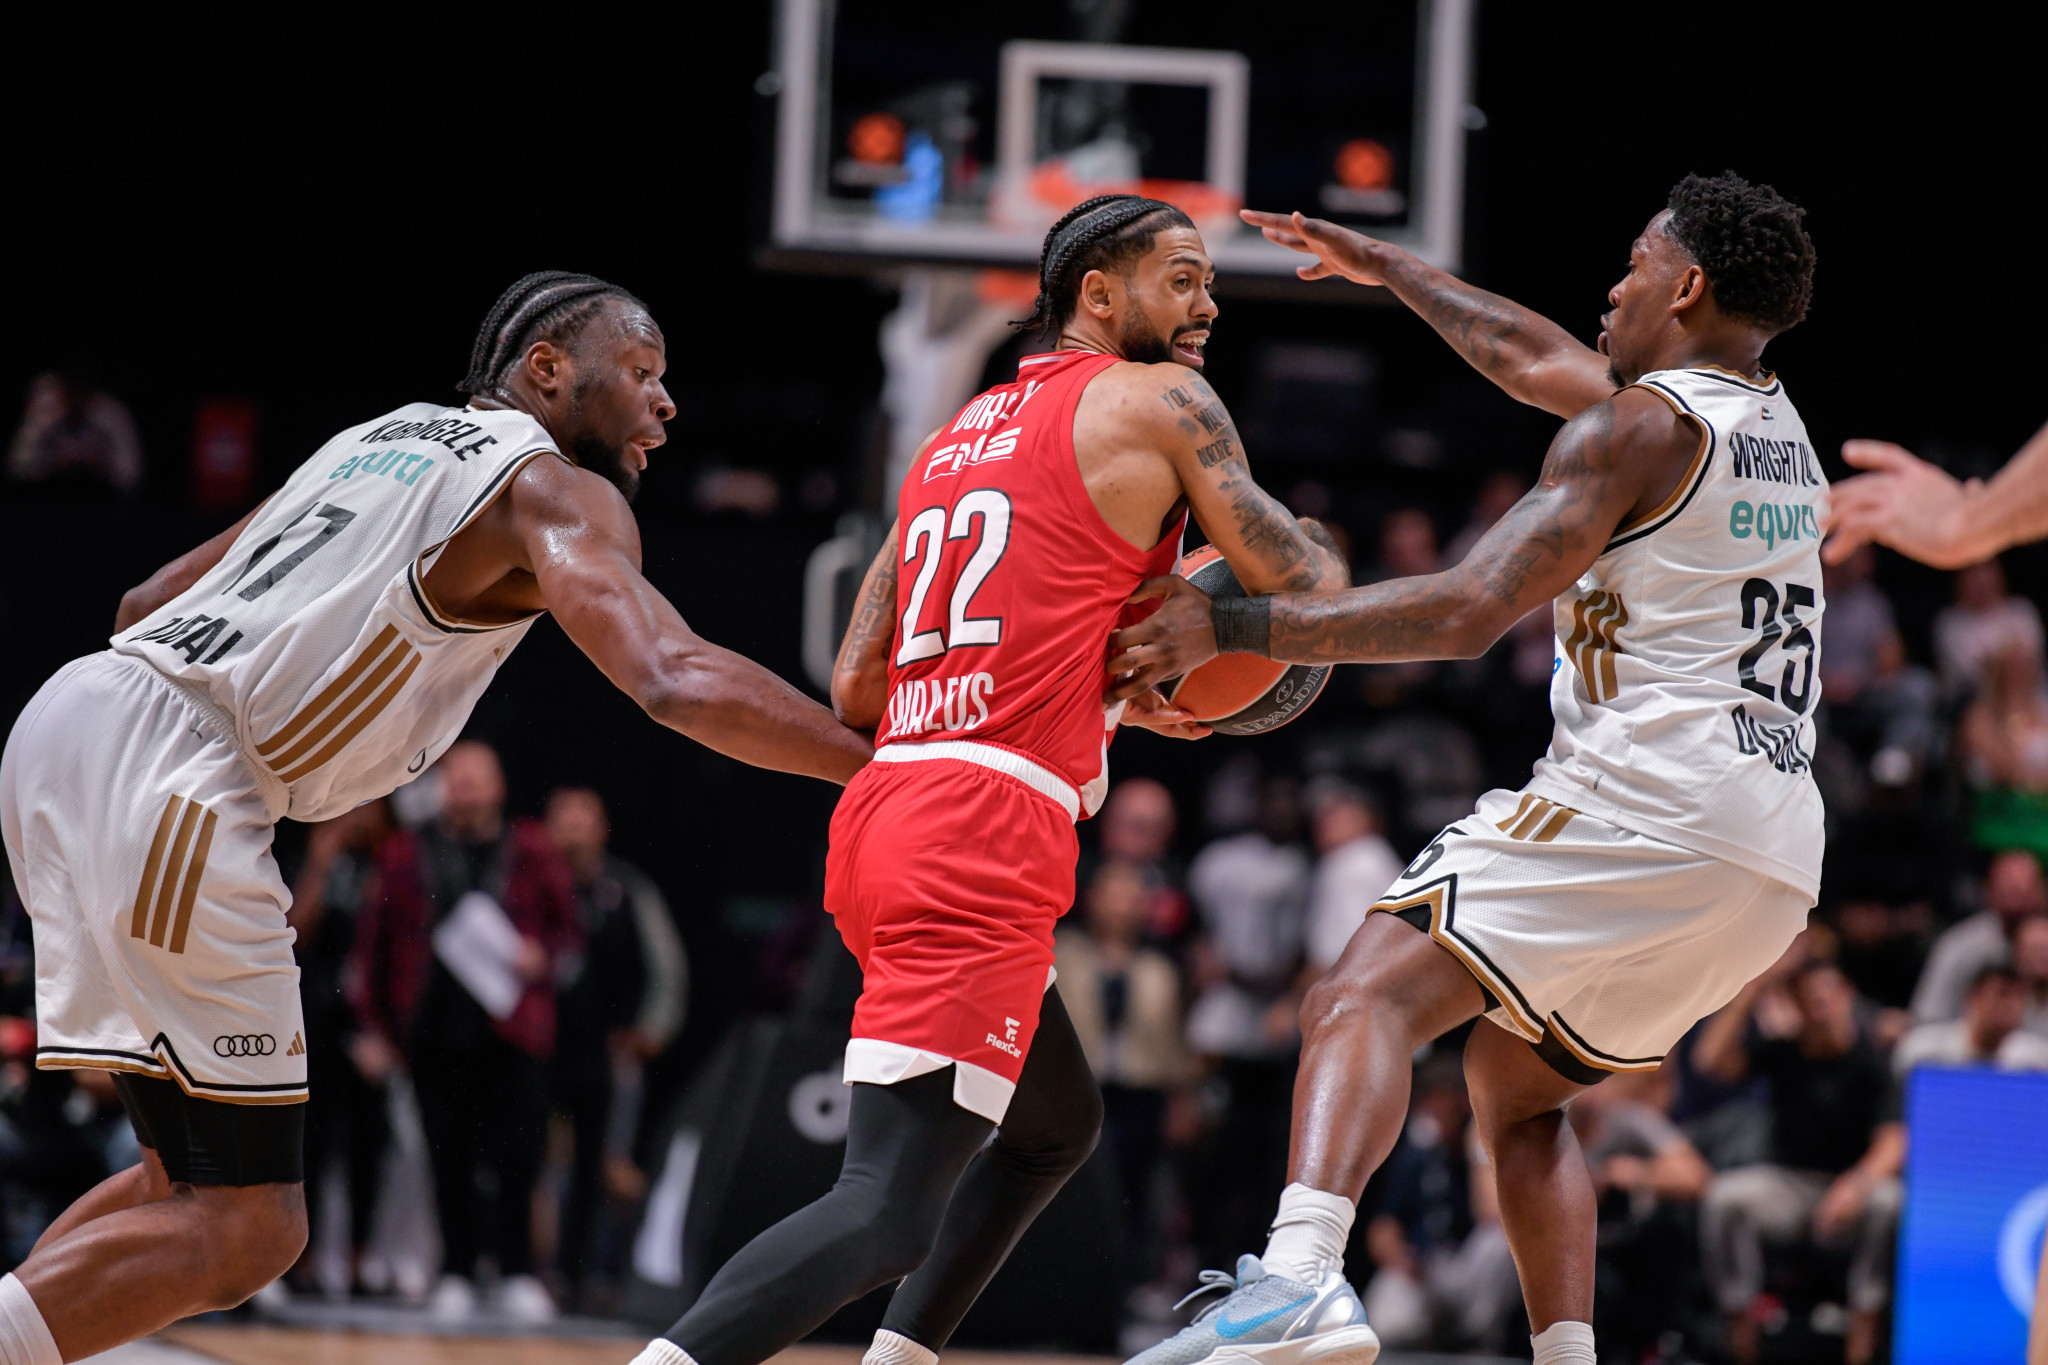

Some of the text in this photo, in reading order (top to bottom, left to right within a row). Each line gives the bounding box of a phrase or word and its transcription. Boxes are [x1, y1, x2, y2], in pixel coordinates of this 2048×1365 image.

[1729, 432, 1796, 486] WRIGHT
[221, 501, 357, 602] 17
[896, 487, 1013, 669] 22
[1738, 578, 1815, 716] 25
[1232, 666, 1326, 732] SPALDIN
[985, 1032, 1022, 1059] FlexCar
